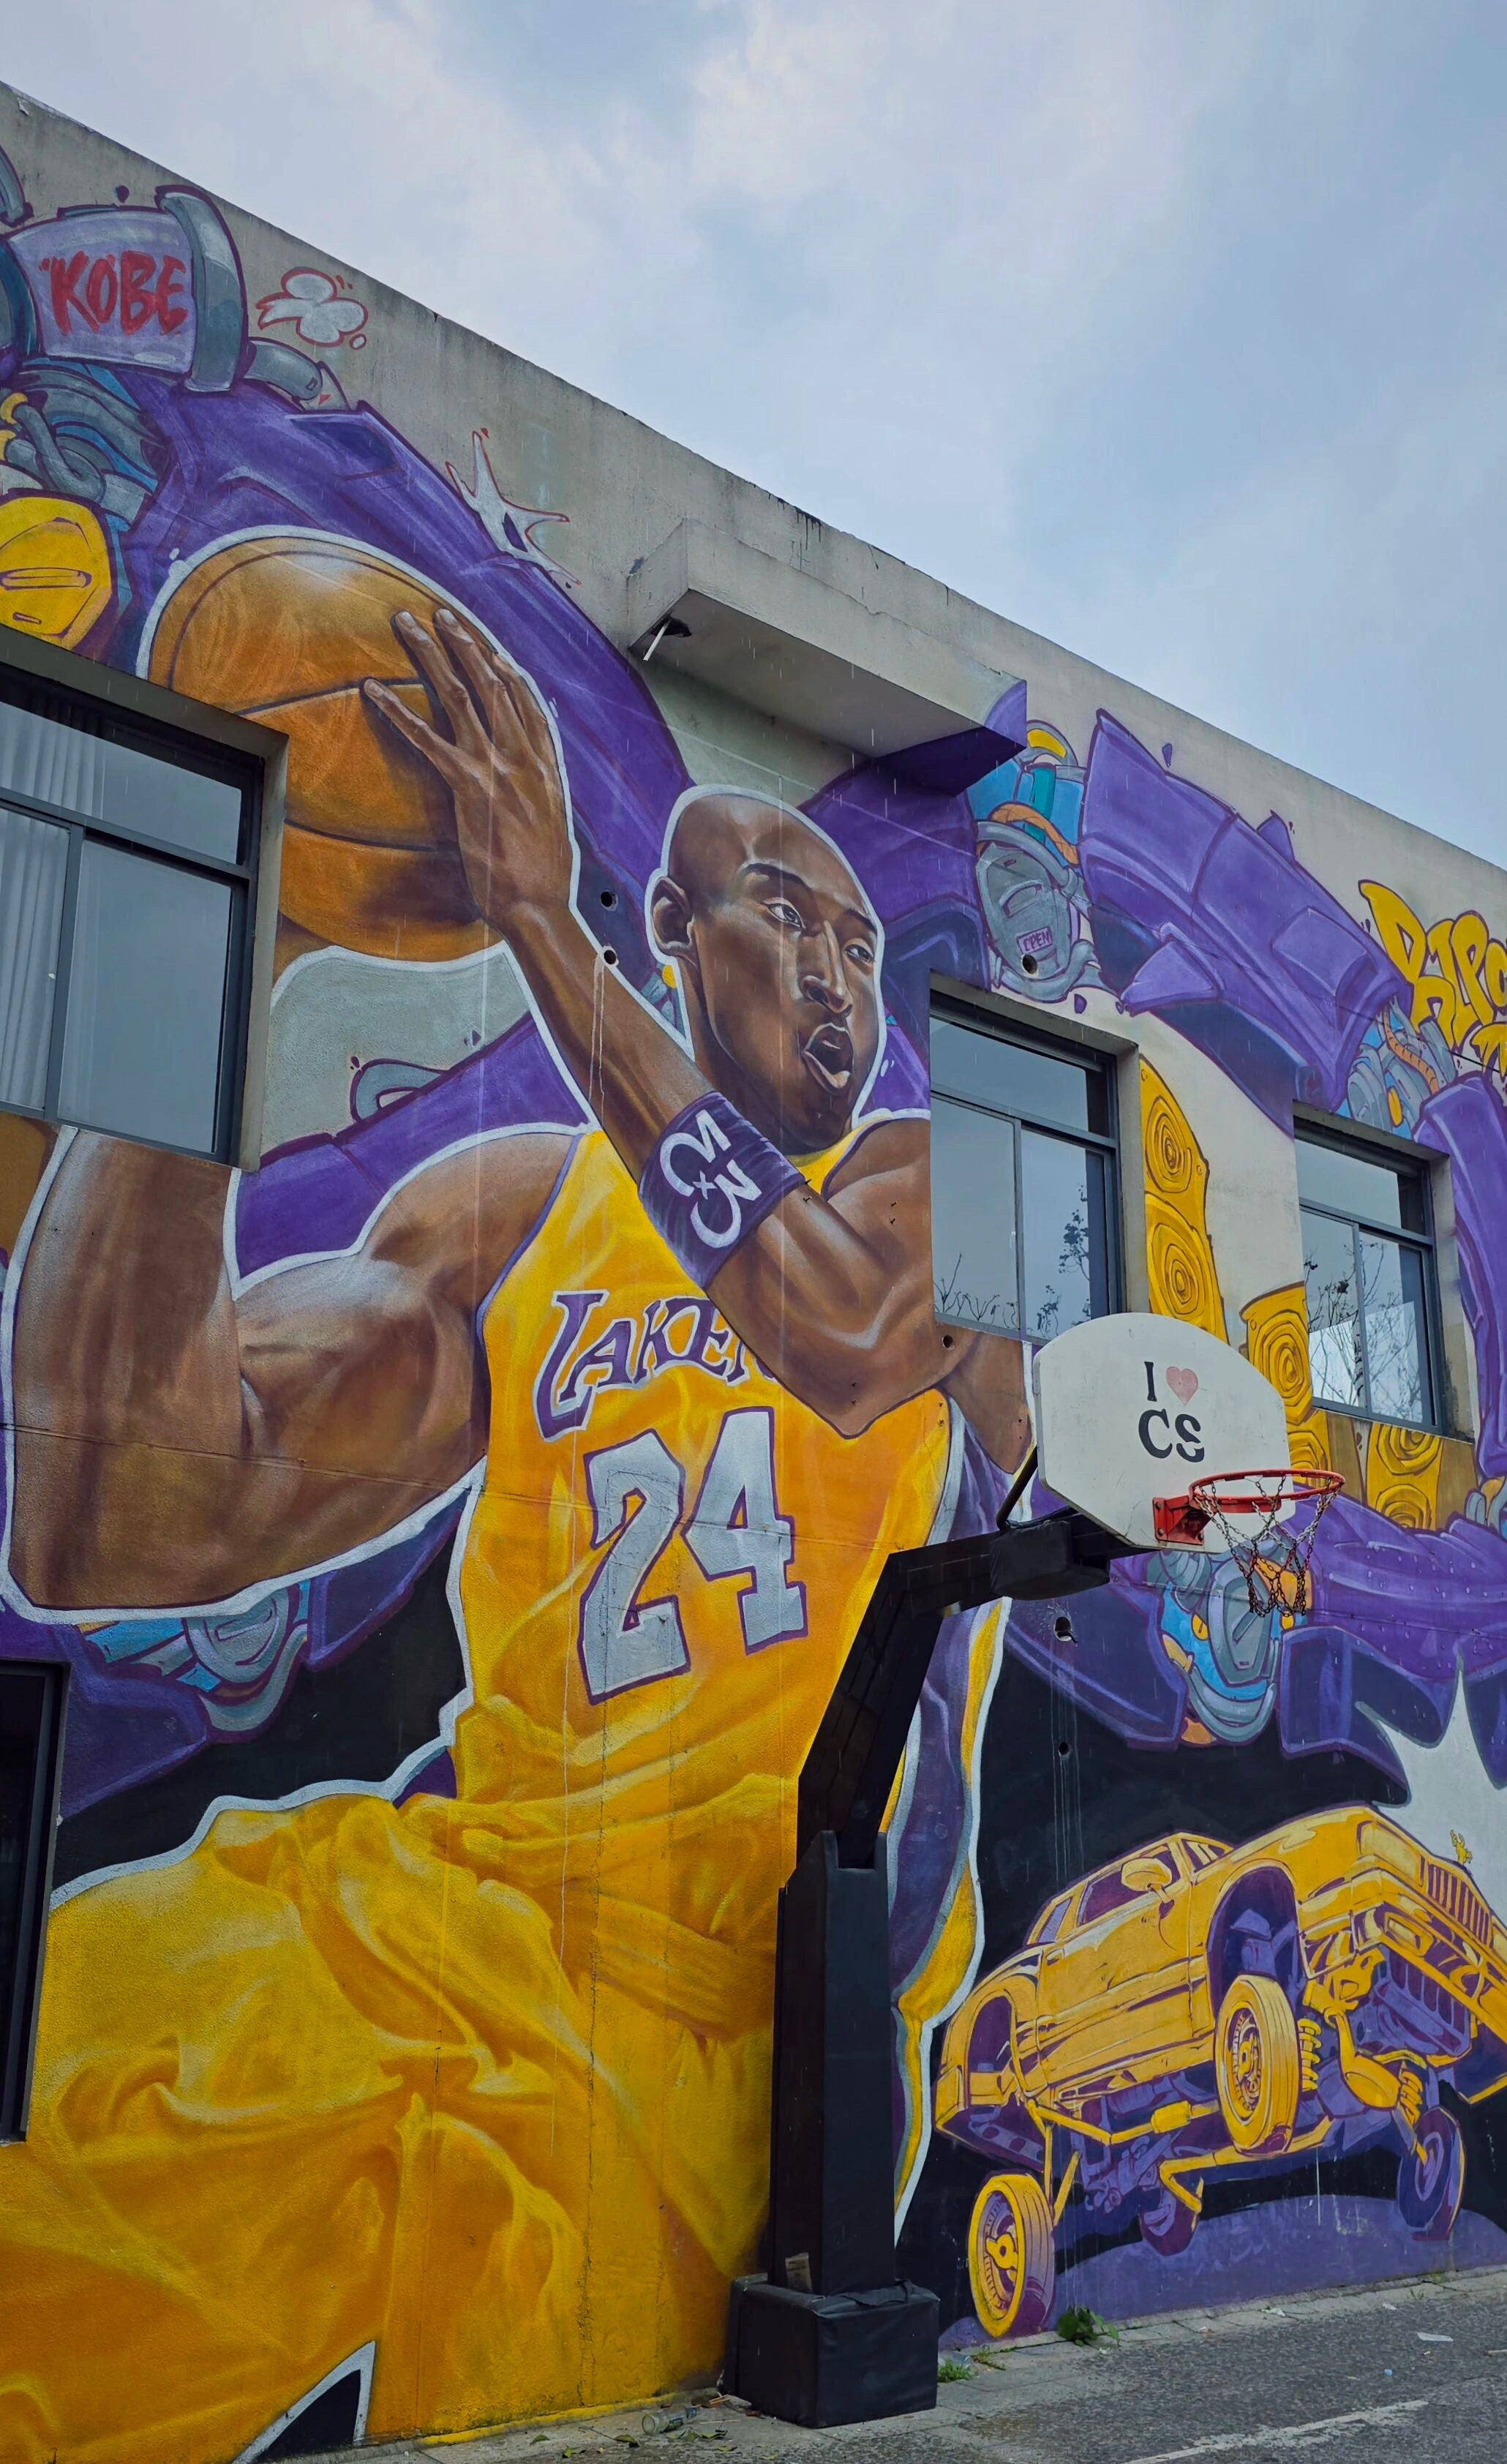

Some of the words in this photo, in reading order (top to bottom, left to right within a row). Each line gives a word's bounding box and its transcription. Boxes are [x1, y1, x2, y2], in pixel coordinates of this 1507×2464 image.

[1023, 930, 1051, 951] OPEN
[1144, 1361, 1157, 1402] I
[1138, 1408, 1205, 1462] CS
[576, 1406, 808, 1705] 24
